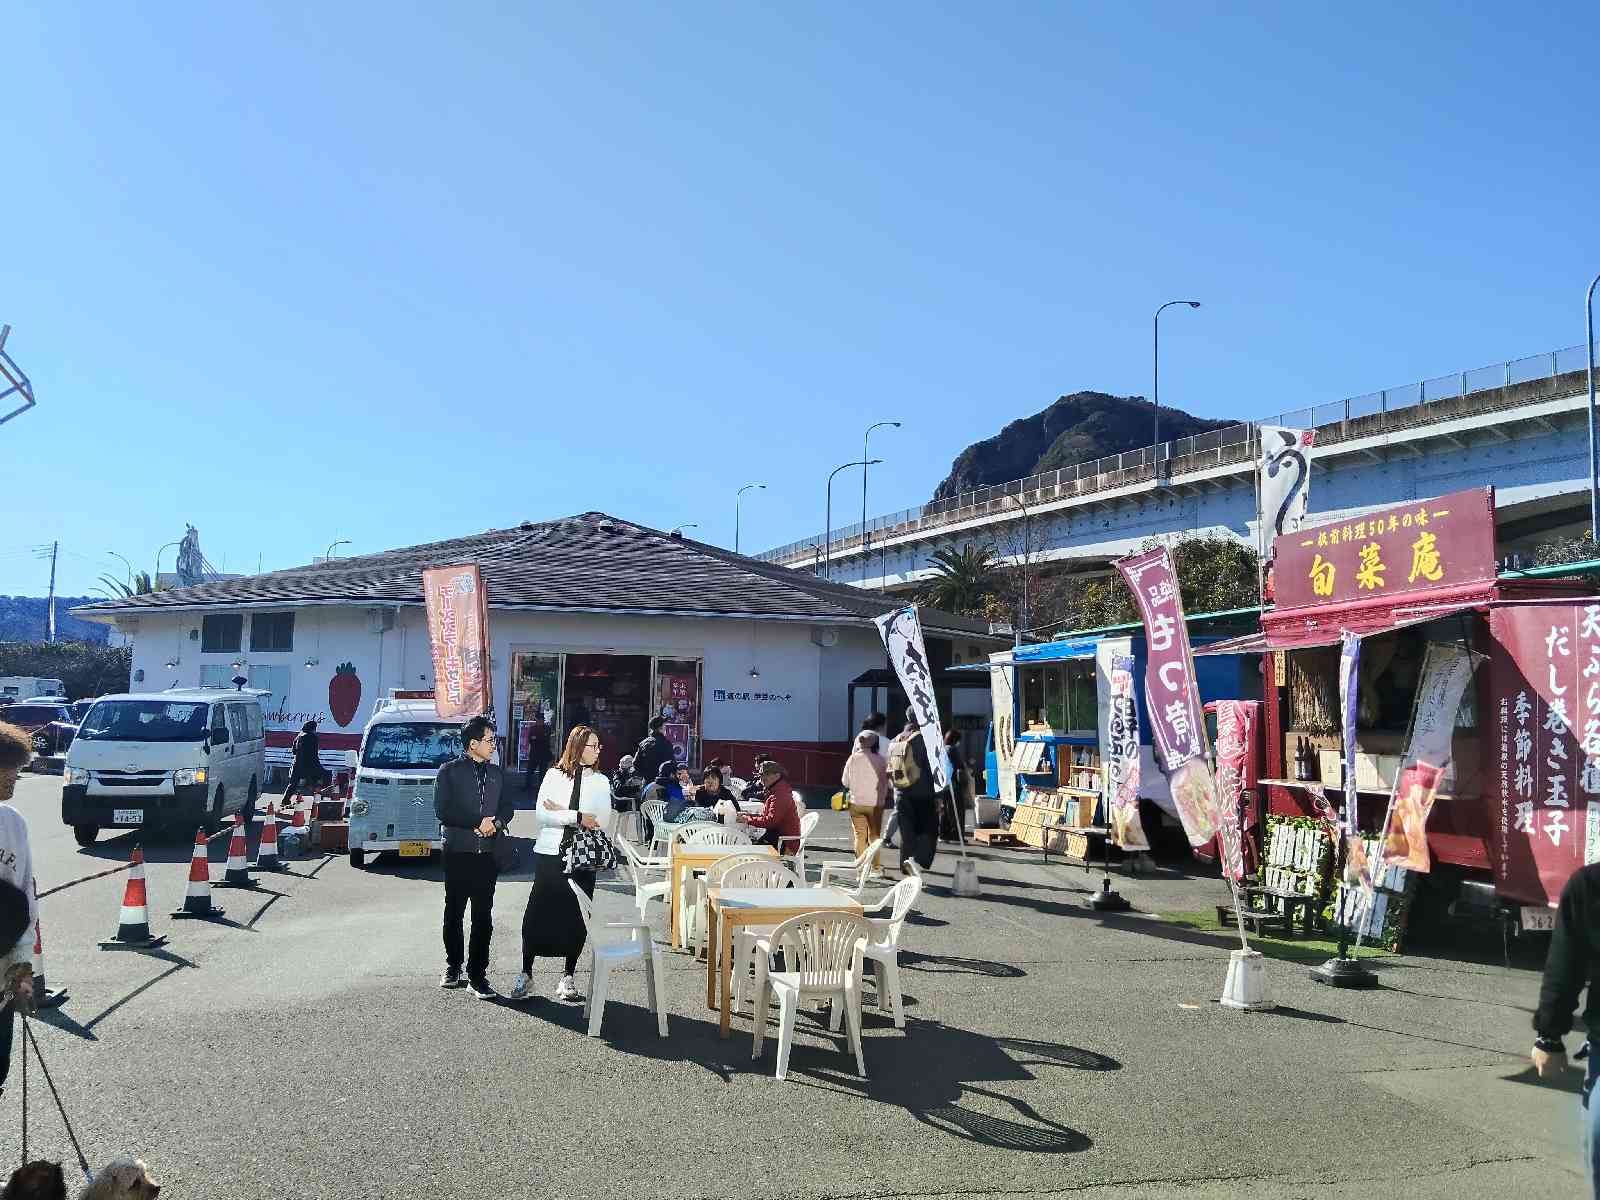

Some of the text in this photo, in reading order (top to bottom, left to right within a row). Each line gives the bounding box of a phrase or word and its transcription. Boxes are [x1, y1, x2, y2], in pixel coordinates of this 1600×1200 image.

[1309, 531, 1443, 596] 旬菜庵
[1513, 690, 1536, 835] 季節料理
[1543, 625, 1571, 847] だし巻き玉子
